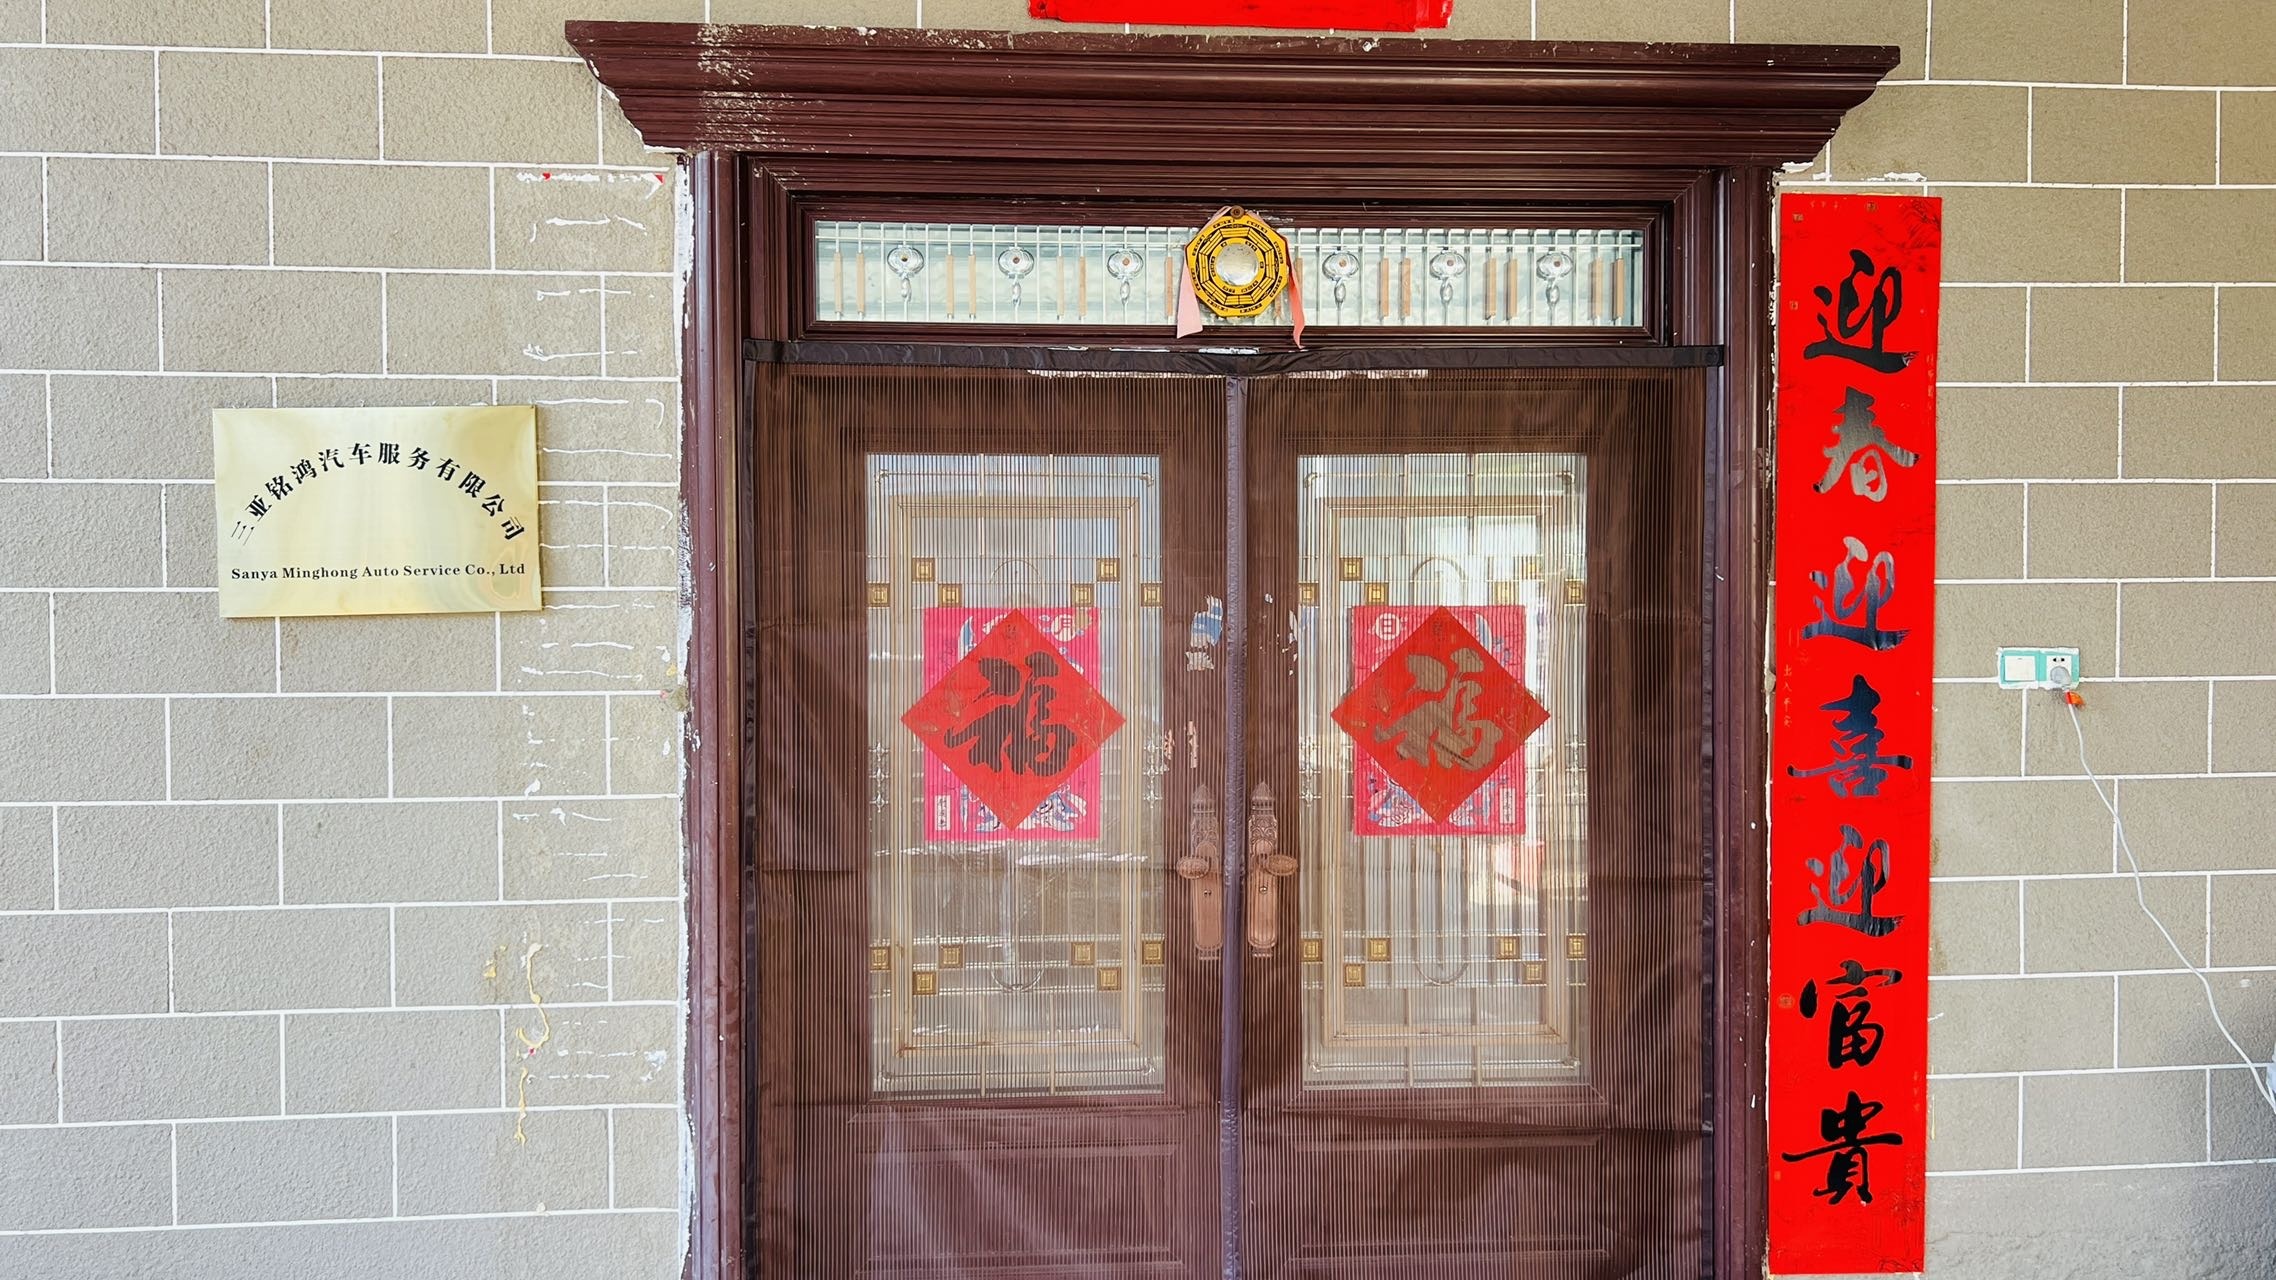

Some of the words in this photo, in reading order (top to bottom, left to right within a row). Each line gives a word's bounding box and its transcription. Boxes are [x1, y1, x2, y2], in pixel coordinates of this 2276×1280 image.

[230, 442, 525, 546] 三亚铭鸿汽车服务有限公司
[231, 568, 278, 581] Sanya
[282, 566, 358, 580] Minghong
[362, 566, 399, 577] Auto
[403, 564, 460, 576] Service
[465, 563, 496, 576] Co.,
[500, 563, 526, 575] Ltd
[943, 652, 1078, 777] 福
[1372, 648, 1504, 772] 福
